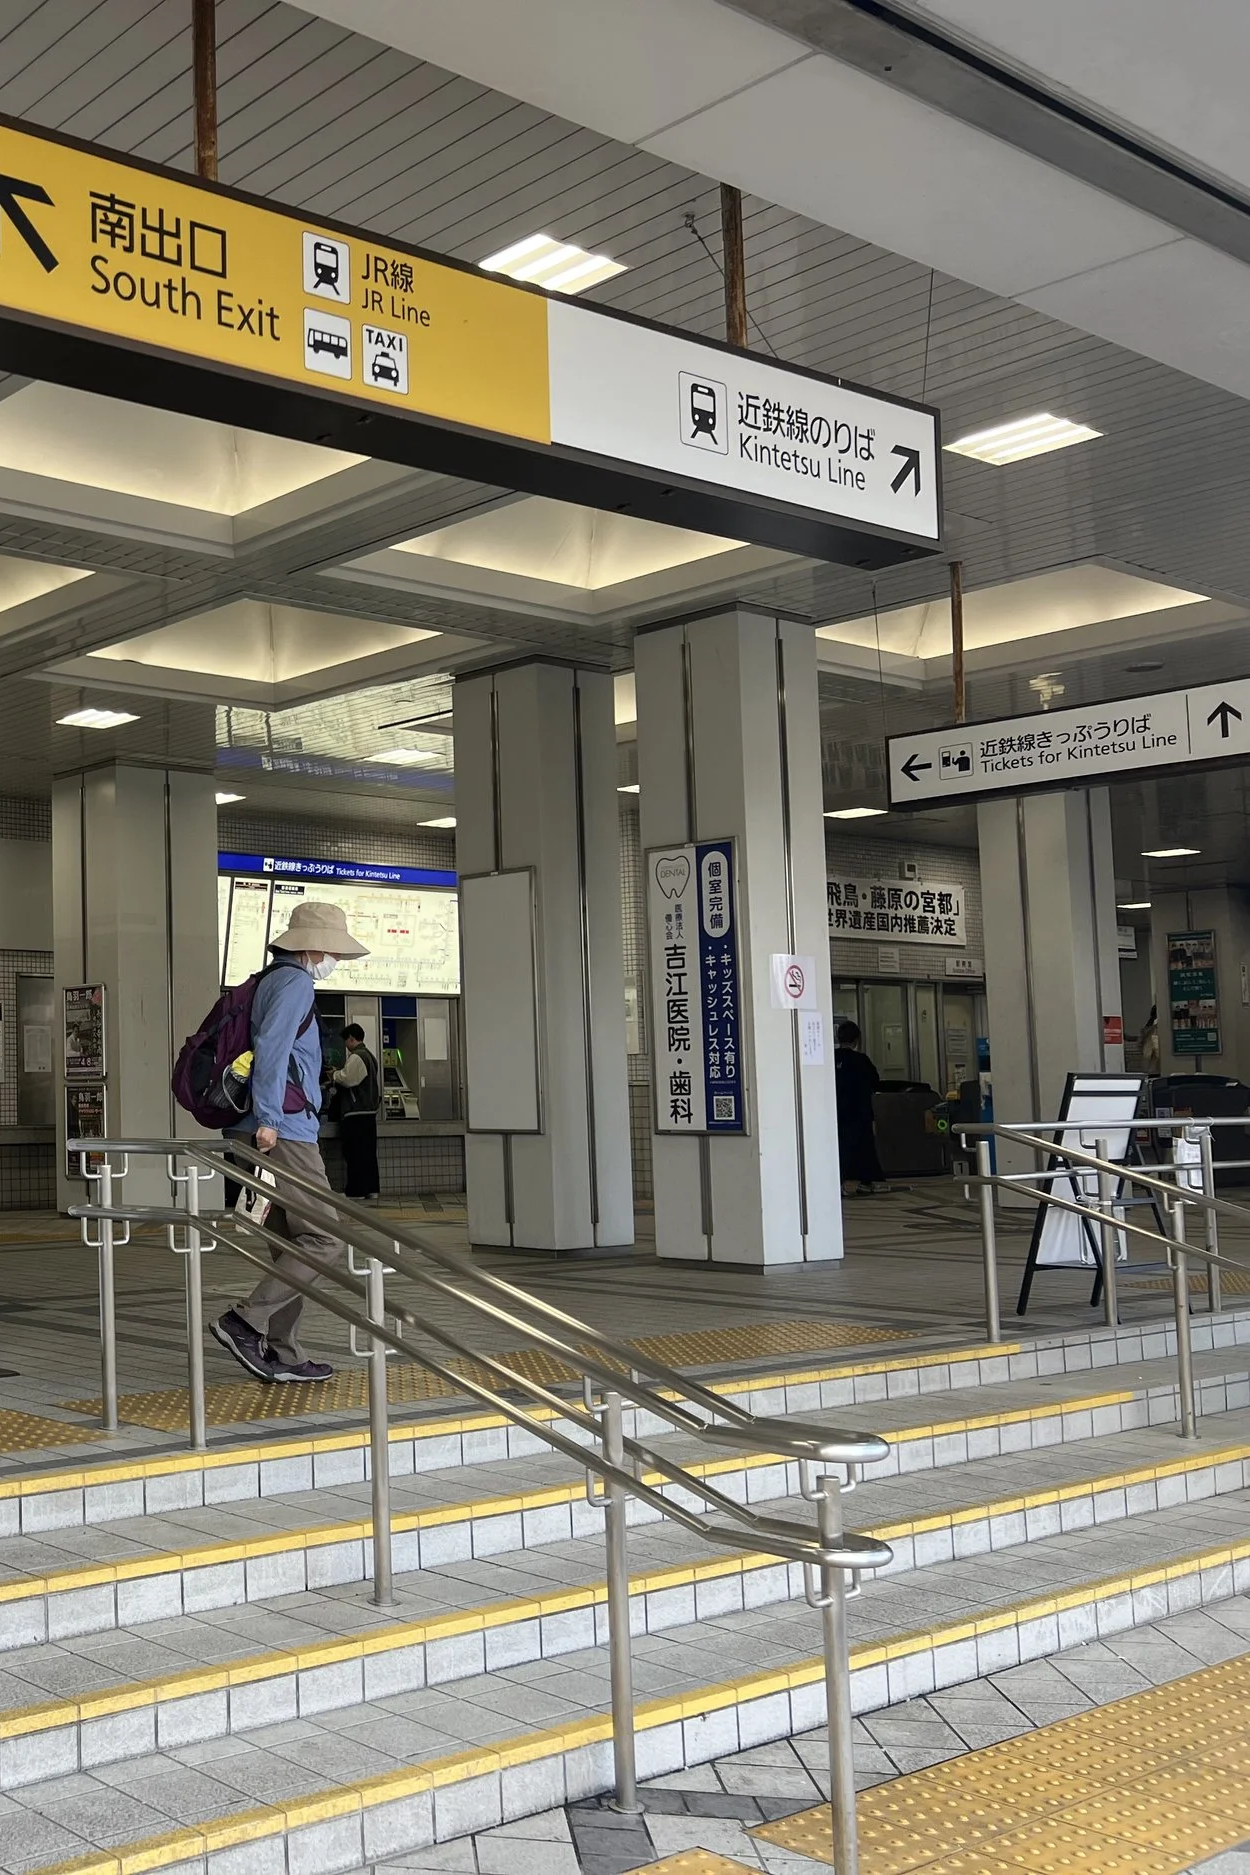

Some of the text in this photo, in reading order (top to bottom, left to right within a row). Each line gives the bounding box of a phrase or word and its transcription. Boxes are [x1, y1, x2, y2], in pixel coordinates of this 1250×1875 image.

[89, 191, 227, 279] 南出口
[361, 253, 414, 293] JR線
[90, 255, 280, 341] South Exit
[361, 288, 431, 327] JR Line
[365, 329, 403, 352] TAXI
[737, 391, 876, 461] 近鉄線のりば
[739, 433, 866, 490] Kintetsu Line
[980, 713, 1152, 758] 近鉄線きっぷうりば
[981, 733, 1177, 773] Tickets for Kintetsu Line
[274, 861, 335, 874] 近鉄線きっぷうりば
[336, 868, 401, 880] Tickets for Kintetsu Line
[660, 868, 686, 878] DENTAL
[708, 862, 724, 929] 個室完備
[675, 904, 684, 939] 医療法人
[664, 944, 693, 1125] 吉江医院・歯科
[958, 1162, 963, 1174] 1
